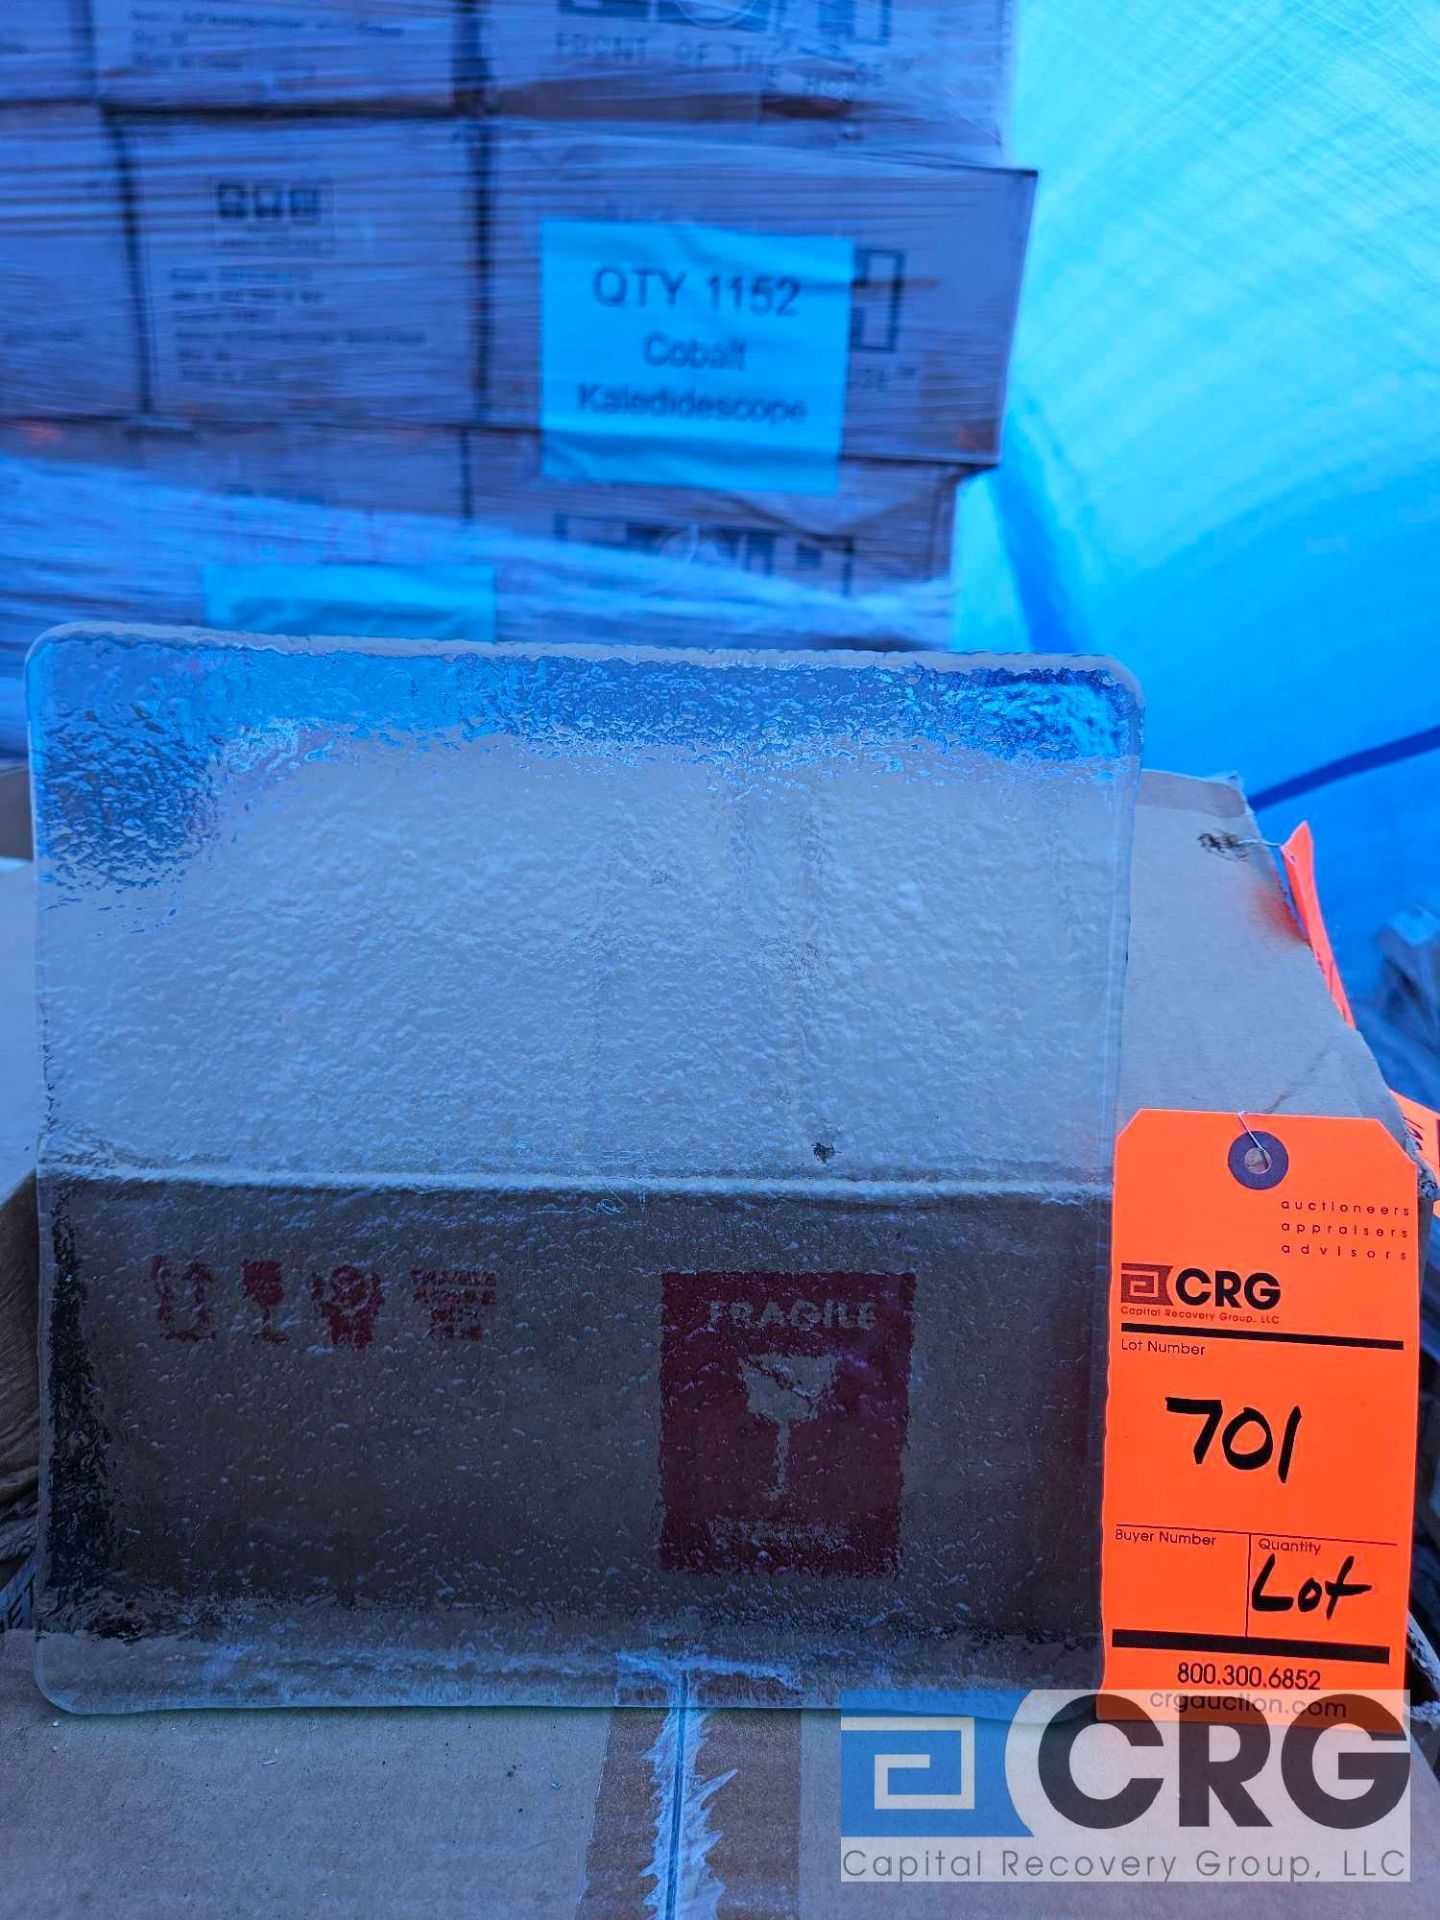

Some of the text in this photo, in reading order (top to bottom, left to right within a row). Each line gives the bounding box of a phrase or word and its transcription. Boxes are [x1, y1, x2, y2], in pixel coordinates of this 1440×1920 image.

[594, 267, 801, 318] QTY 1152
[643, 331, 747, 372] Cobalt
[1280, 1198, 1410, 1217] auctioneers
[1280, 1221, 1409, 1239] appraisers
[1280, 1243, 1408, 1261] advisors
[1175, 1267, 1282, 1311] CRG
[708, 1299, 878, 1331] FRAGILE
[1120, 1306, 1280, 1325] Capital Recovery Group, LLC
[1120, 1338, 1207, 1356] Lot Number
[1165, 1396, 1302, 1484] 701
[1114, 1527, 1217, 1546] Buyer Number
[1258, 1537, 1322, 1555] Quantity
[1251, 1553, 1373, 1620] Lot
[1176, 1661, 1322, 1691] 800.300.6852
[1149, 1691, 1348, 1719] crgauction.com
